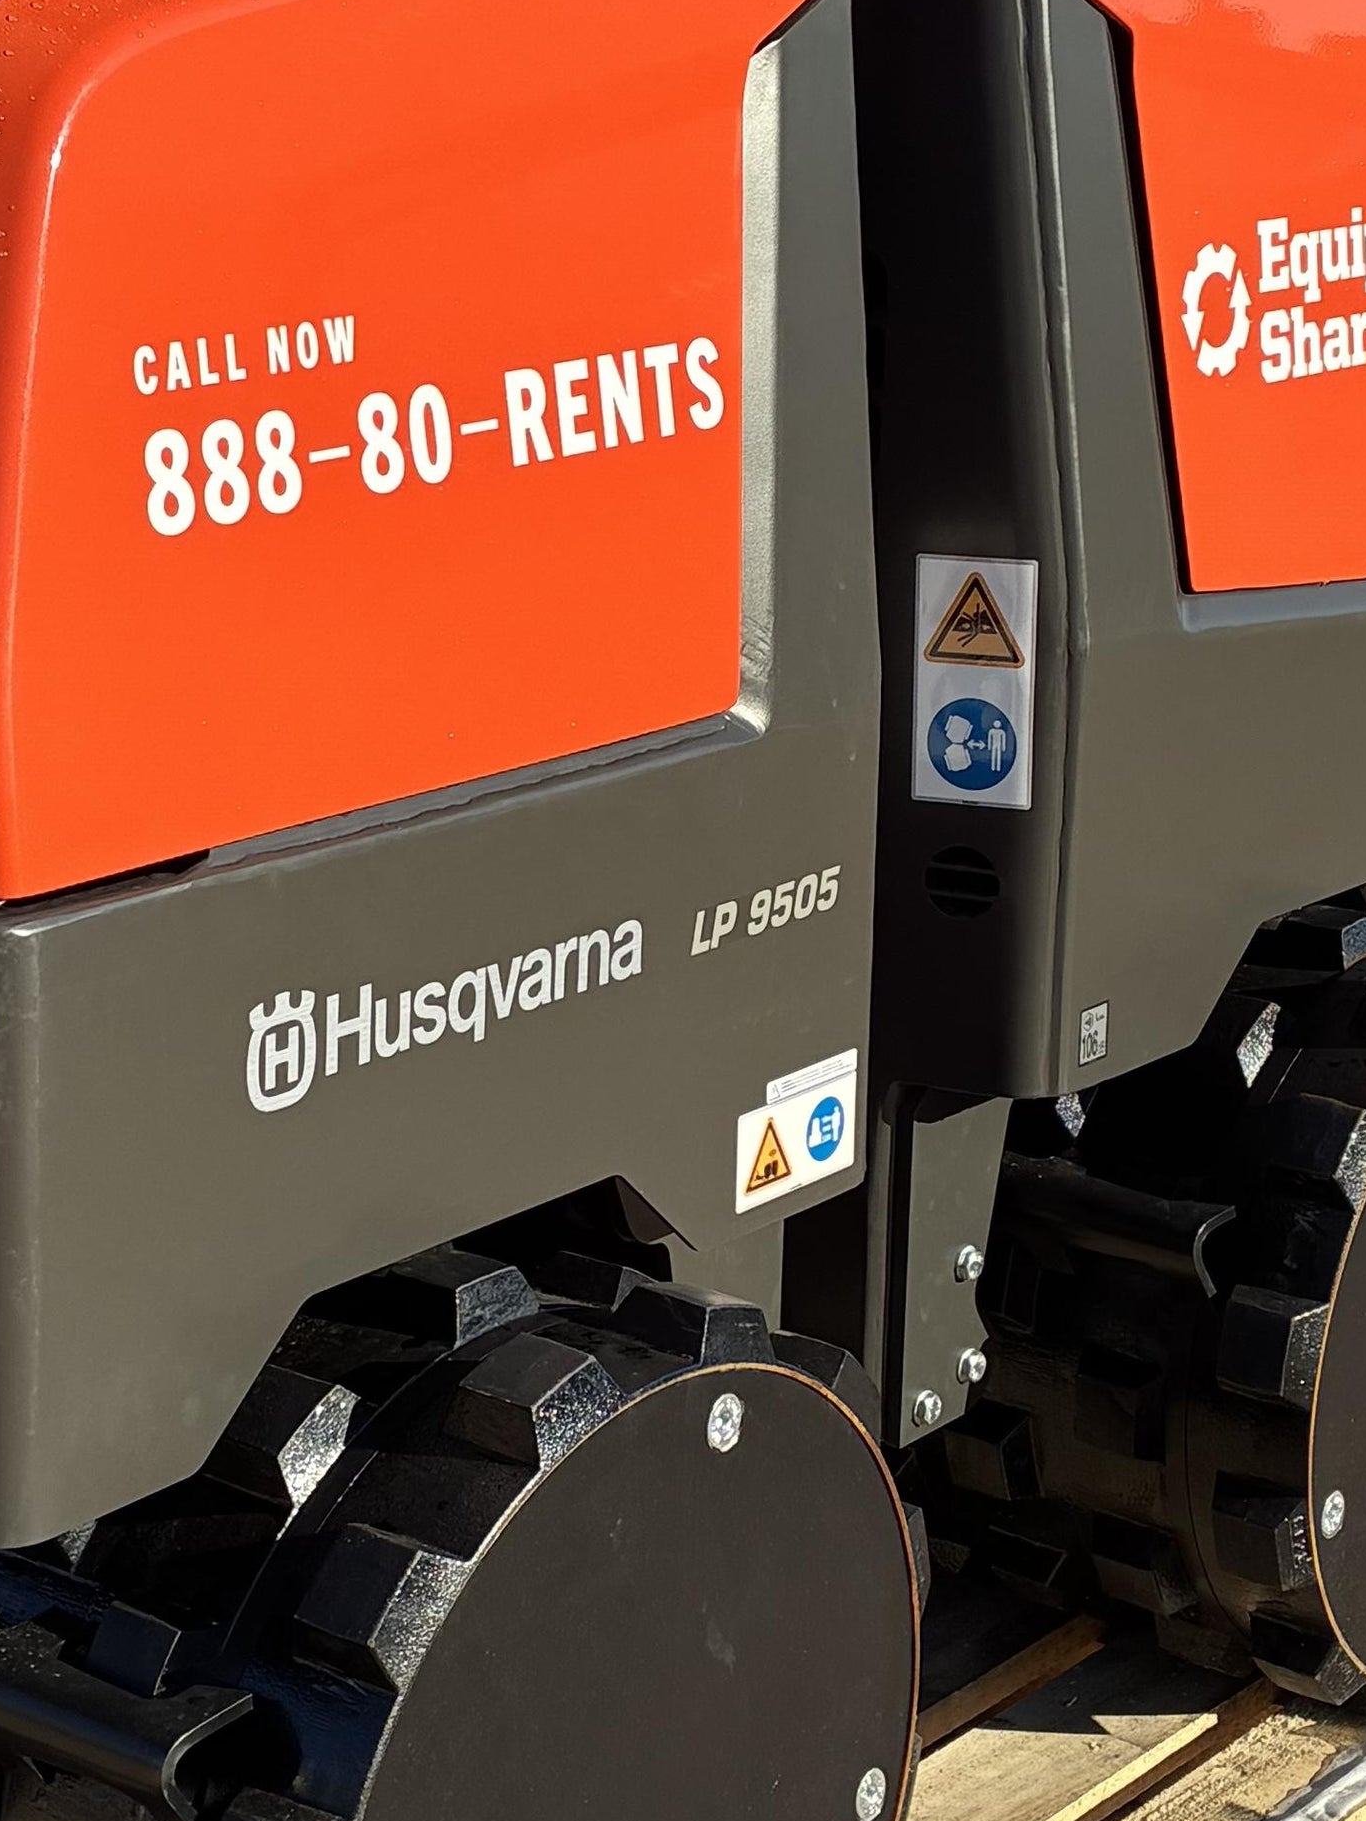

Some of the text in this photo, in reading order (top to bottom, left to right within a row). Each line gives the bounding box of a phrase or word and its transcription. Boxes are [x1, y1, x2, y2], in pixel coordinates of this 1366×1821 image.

[133, 315, 356, 396] CALL NOW
[143, 336, 726, 537] 888-80-RENTS
[690, 865, 842, 957] LP 9505
[324, 919, 644, 1077] Husqvarna
